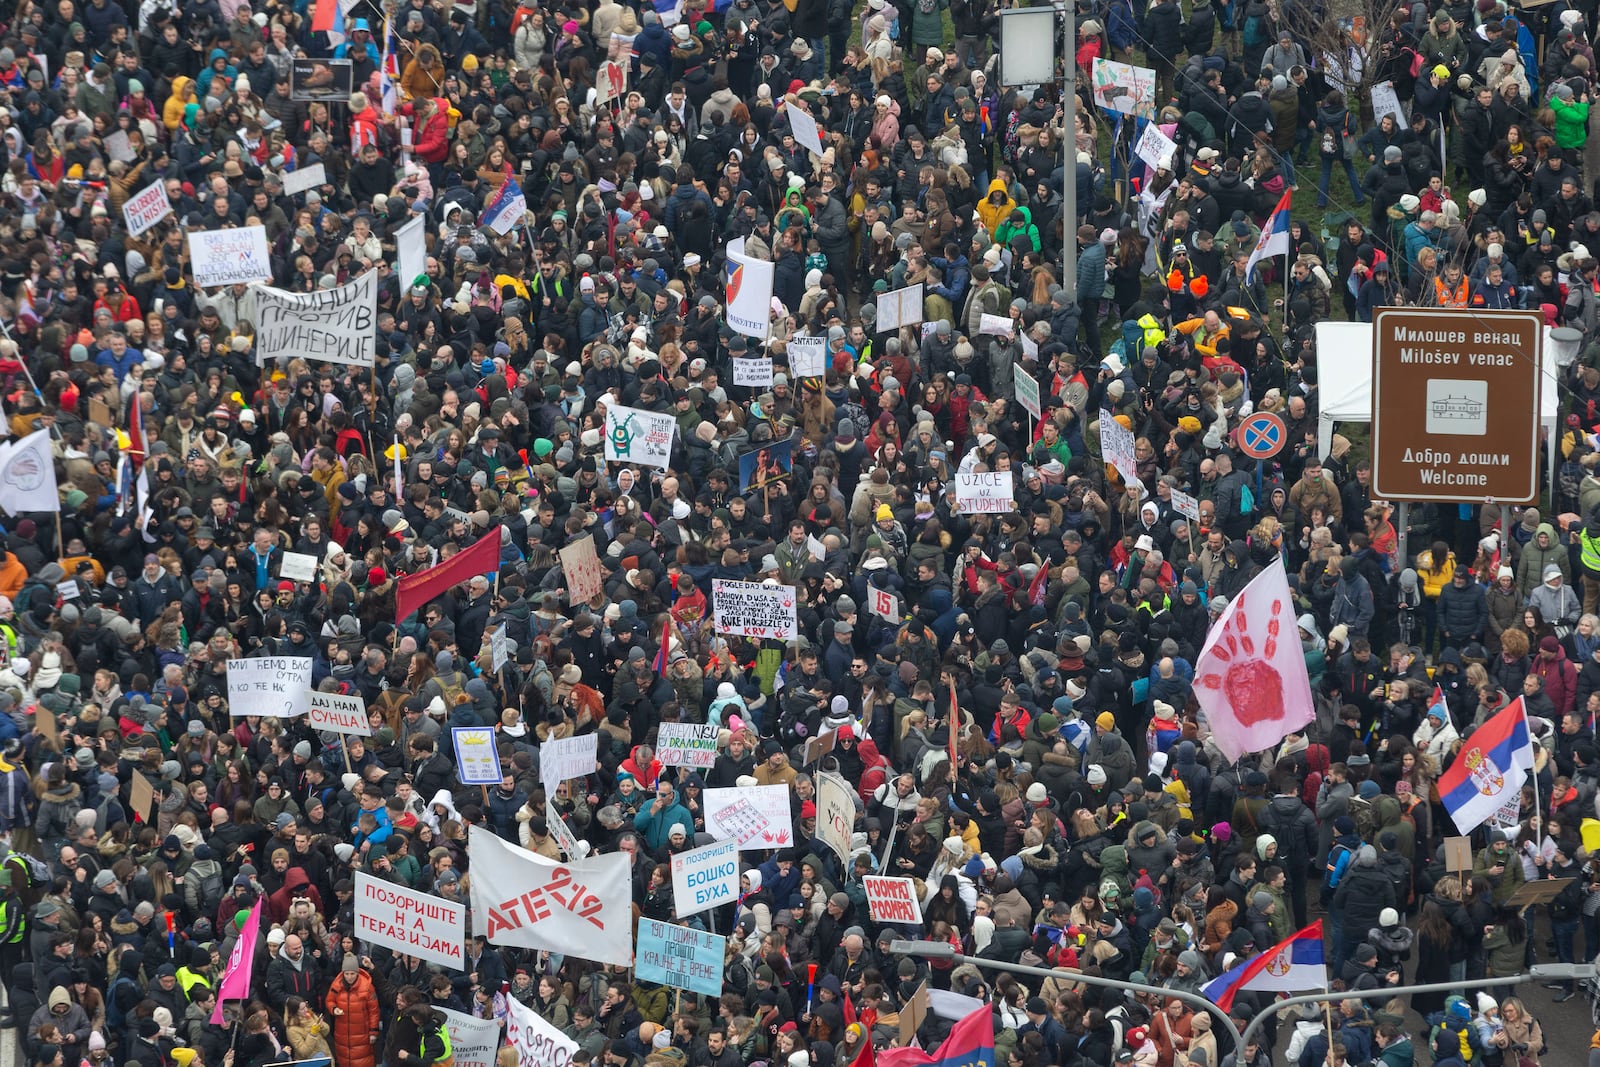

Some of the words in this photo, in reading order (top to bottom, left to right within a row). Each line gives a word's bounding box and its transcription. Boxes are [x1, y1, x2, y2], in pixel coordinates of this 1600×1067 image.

[261, 305, 372, 331] ПРОТИВ
[261, 326, 373, 361] АШИНЕРИЈЕ
[1394, 326, 1466, 343] Милошев
[1473, 333, 1522, 346] венац
[1400, 347, 1460, 364] Milošev
[1468, 354, 1514, 366] venac
[1402, 447, 1451, 467] Добро
[1458, 453, 1510, 466] дошли
[1420, 469, 1488, 485] Welcome
[979, 488, 992, 497] UZ
[876, 591, 891, 615] 15
[721, 616, 742, 627] RUKE
[744, 626, 767, 636] KRV
[229, 660, 248, 671] МИ
[255, 659, 287, 671] ЋЕМО
[292, 659, 311, 671] ВАС
[253, 682, 268, 692] ЋЕ
[272, 682, 287, 693] НАС
[311, 696, 330, 708] ДАЈ
[334, 700, 360, 713] НАМ
[693, 725, 719, 740] NISU
[686, 843, 735, 865] ПОЗОРИШТЕ
[687, 861, 735, 888] БОШКО
[696, 882, 730, 905] БУХА
[365, 884, 457, 925] ПОЗОРИШТЕ
[360, 914, 461, 958] ТЕРАЗИЈАМА
[651, 922, 665, 939] 190
[667, 925, 699, 947] ГОДИНА
[689, 961, 715, 980] ВРЕМЕ
